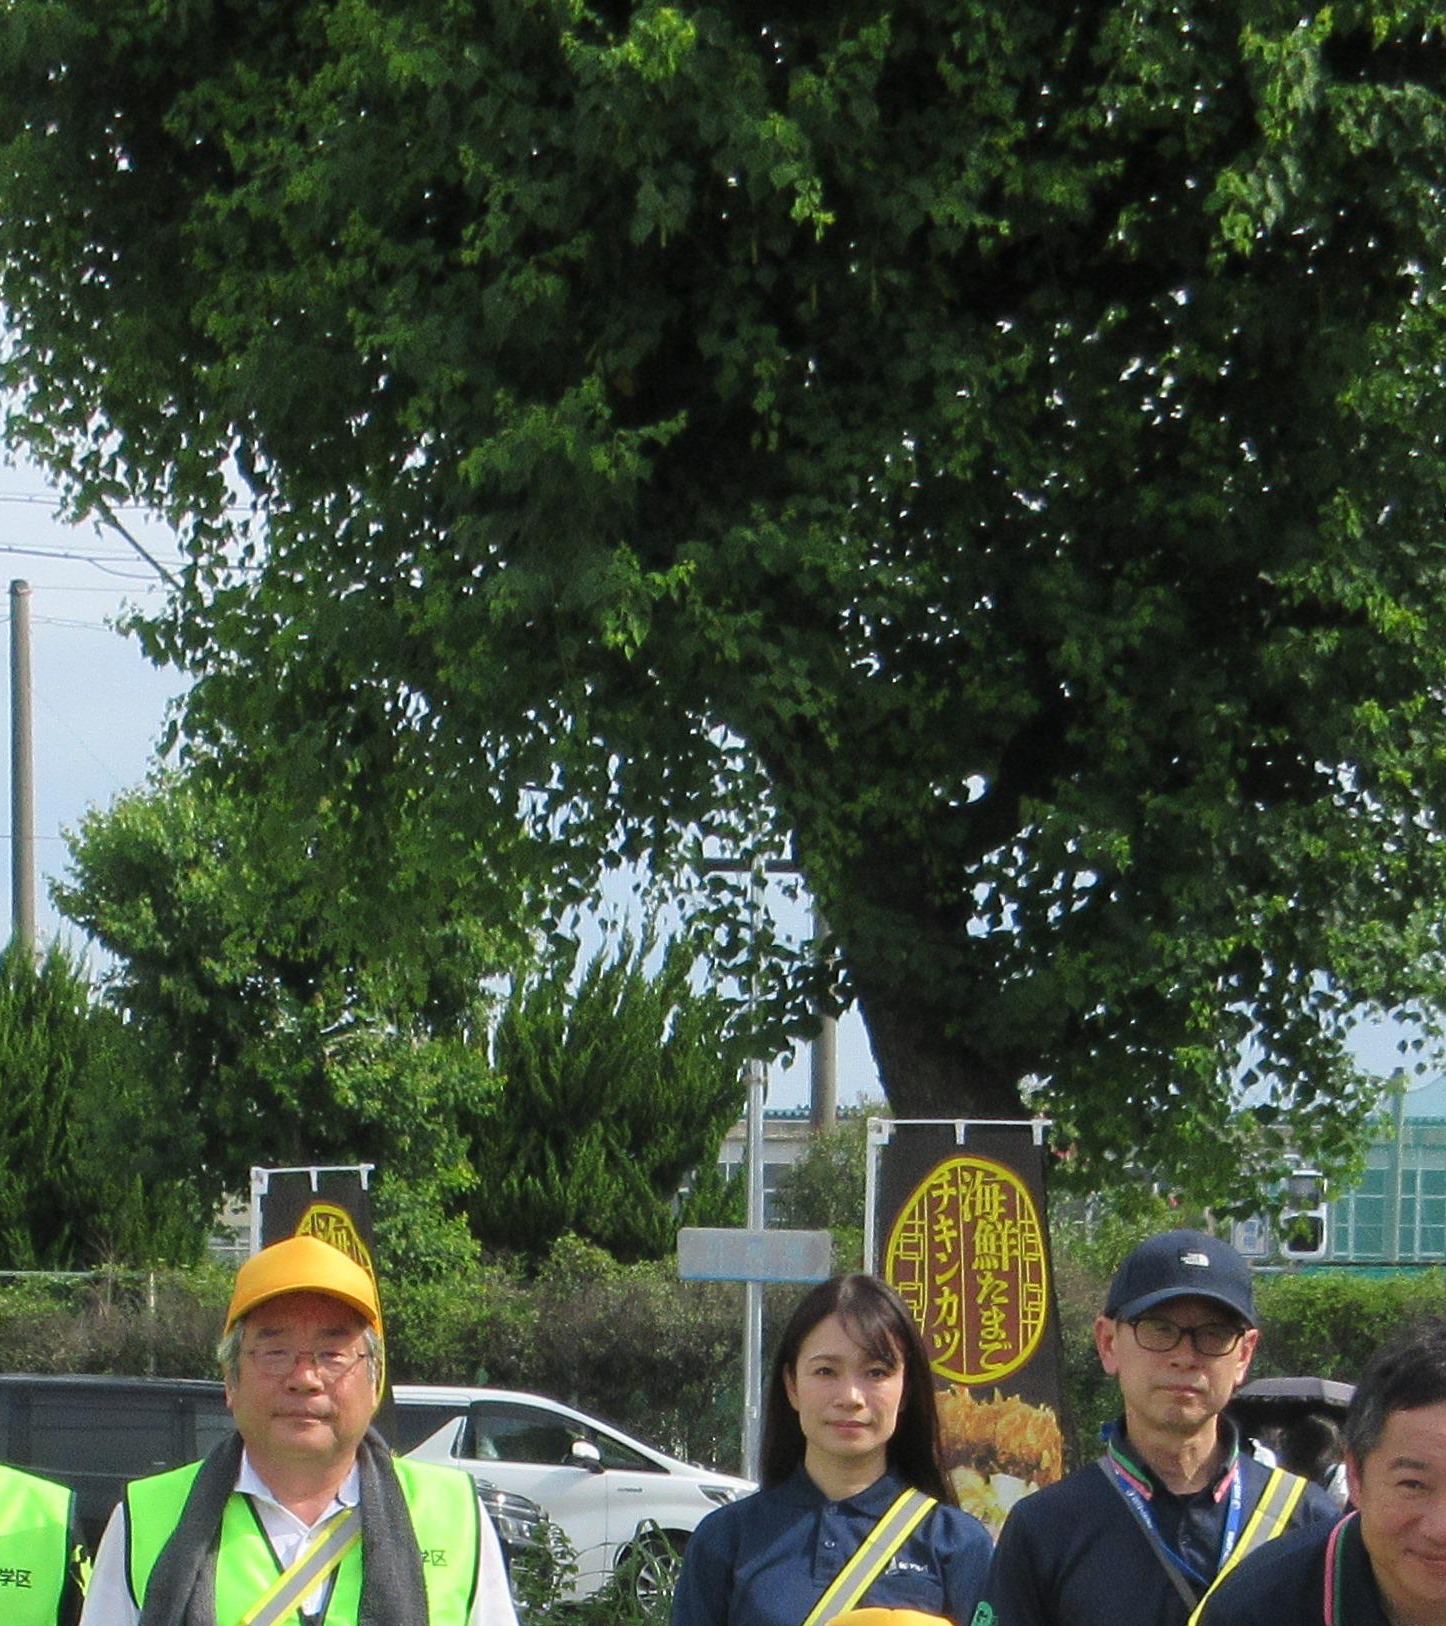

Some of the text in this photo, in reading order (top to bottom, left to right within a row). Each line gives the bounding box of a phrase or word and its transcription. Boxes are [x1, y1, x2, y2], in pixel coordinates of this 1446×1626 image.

[930, 1170, 960, 1366] チキンカツ
